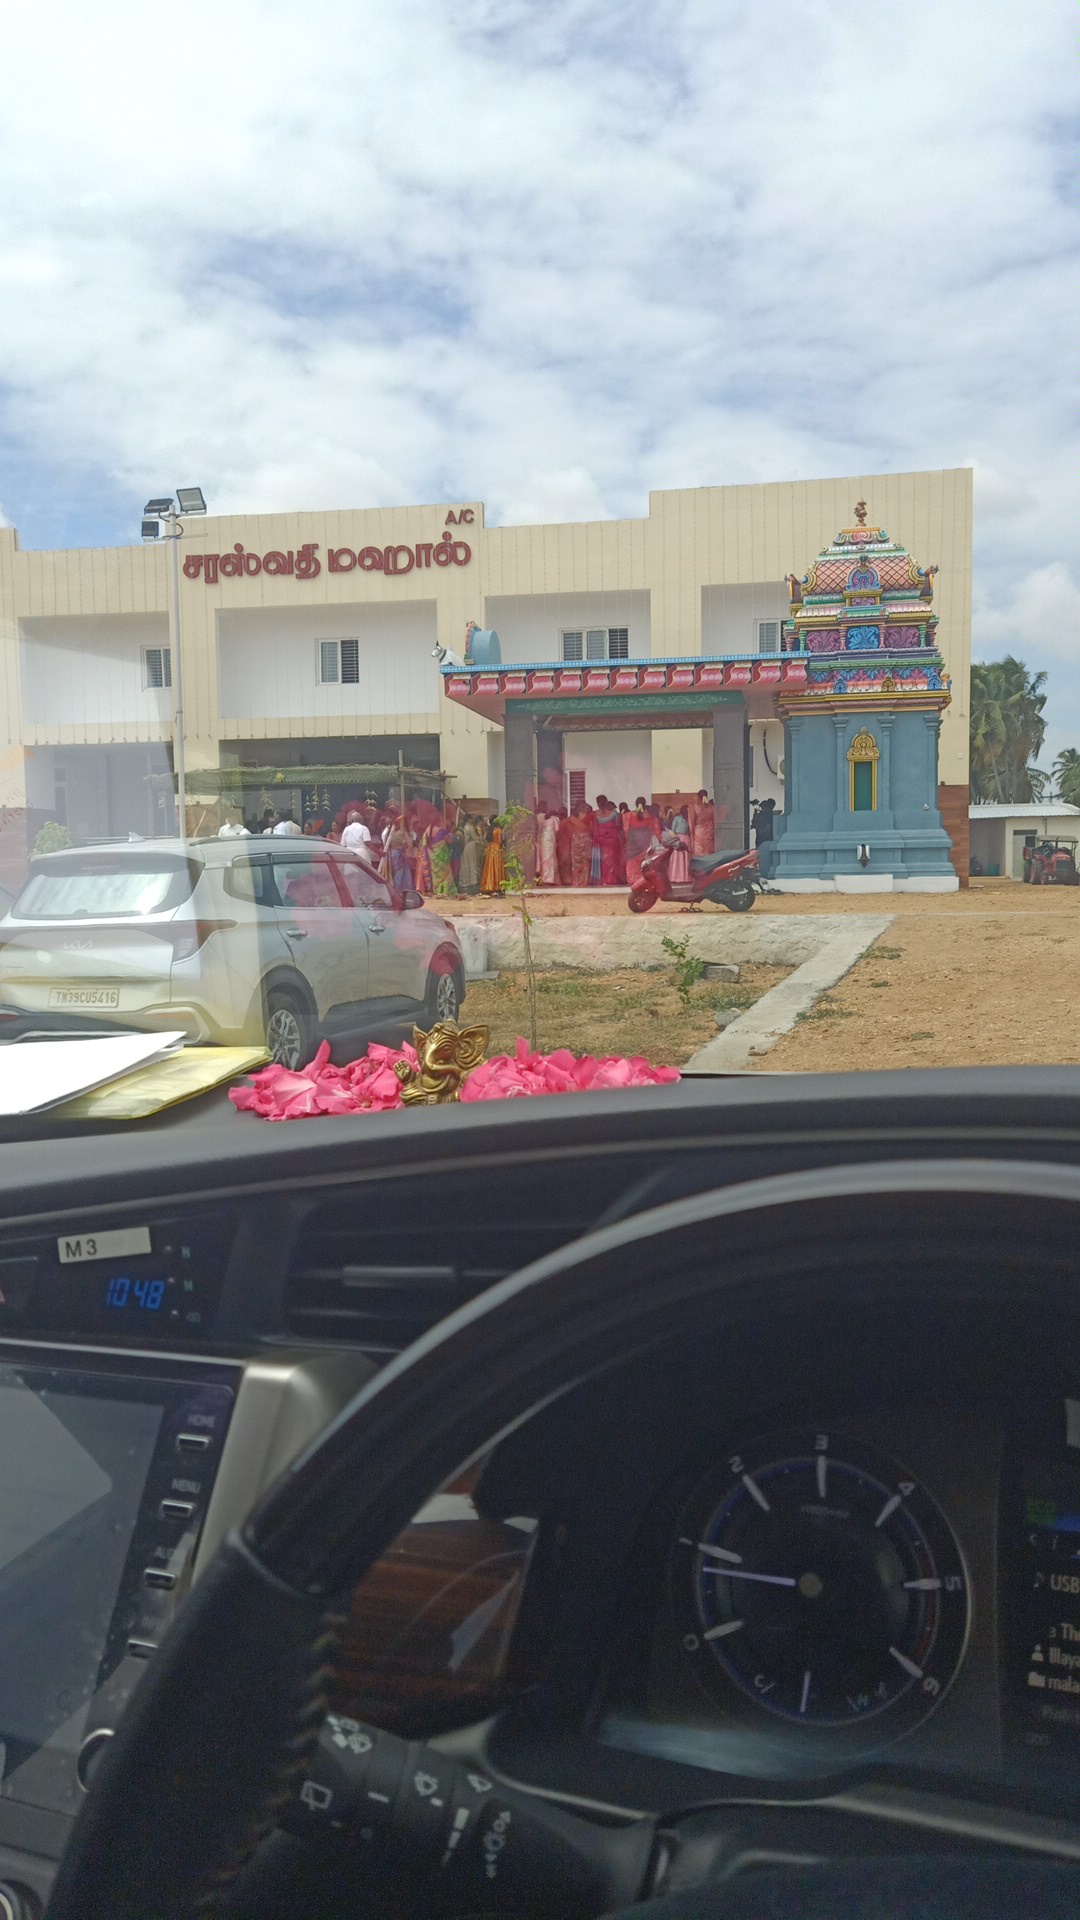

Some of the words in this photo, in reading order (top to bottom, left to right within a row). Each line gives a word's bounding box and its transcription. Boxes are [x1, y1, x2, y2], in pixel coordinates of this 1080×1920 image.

[445, 508, 475, 526] A/C
[182, 542, 321, 584] சரஸ்வதி
[327, 530, 472, 575] மஹால்
[815, 1434, 828, 1450] 3
[728, 1455, 745, 1474] 2
[945, 1575, 961, 1592] 5
[1050, 1574, 1080, 1594] USB
[682, 1634, 700, 1651] 0
[923, 1677, 940, 1696] 6
